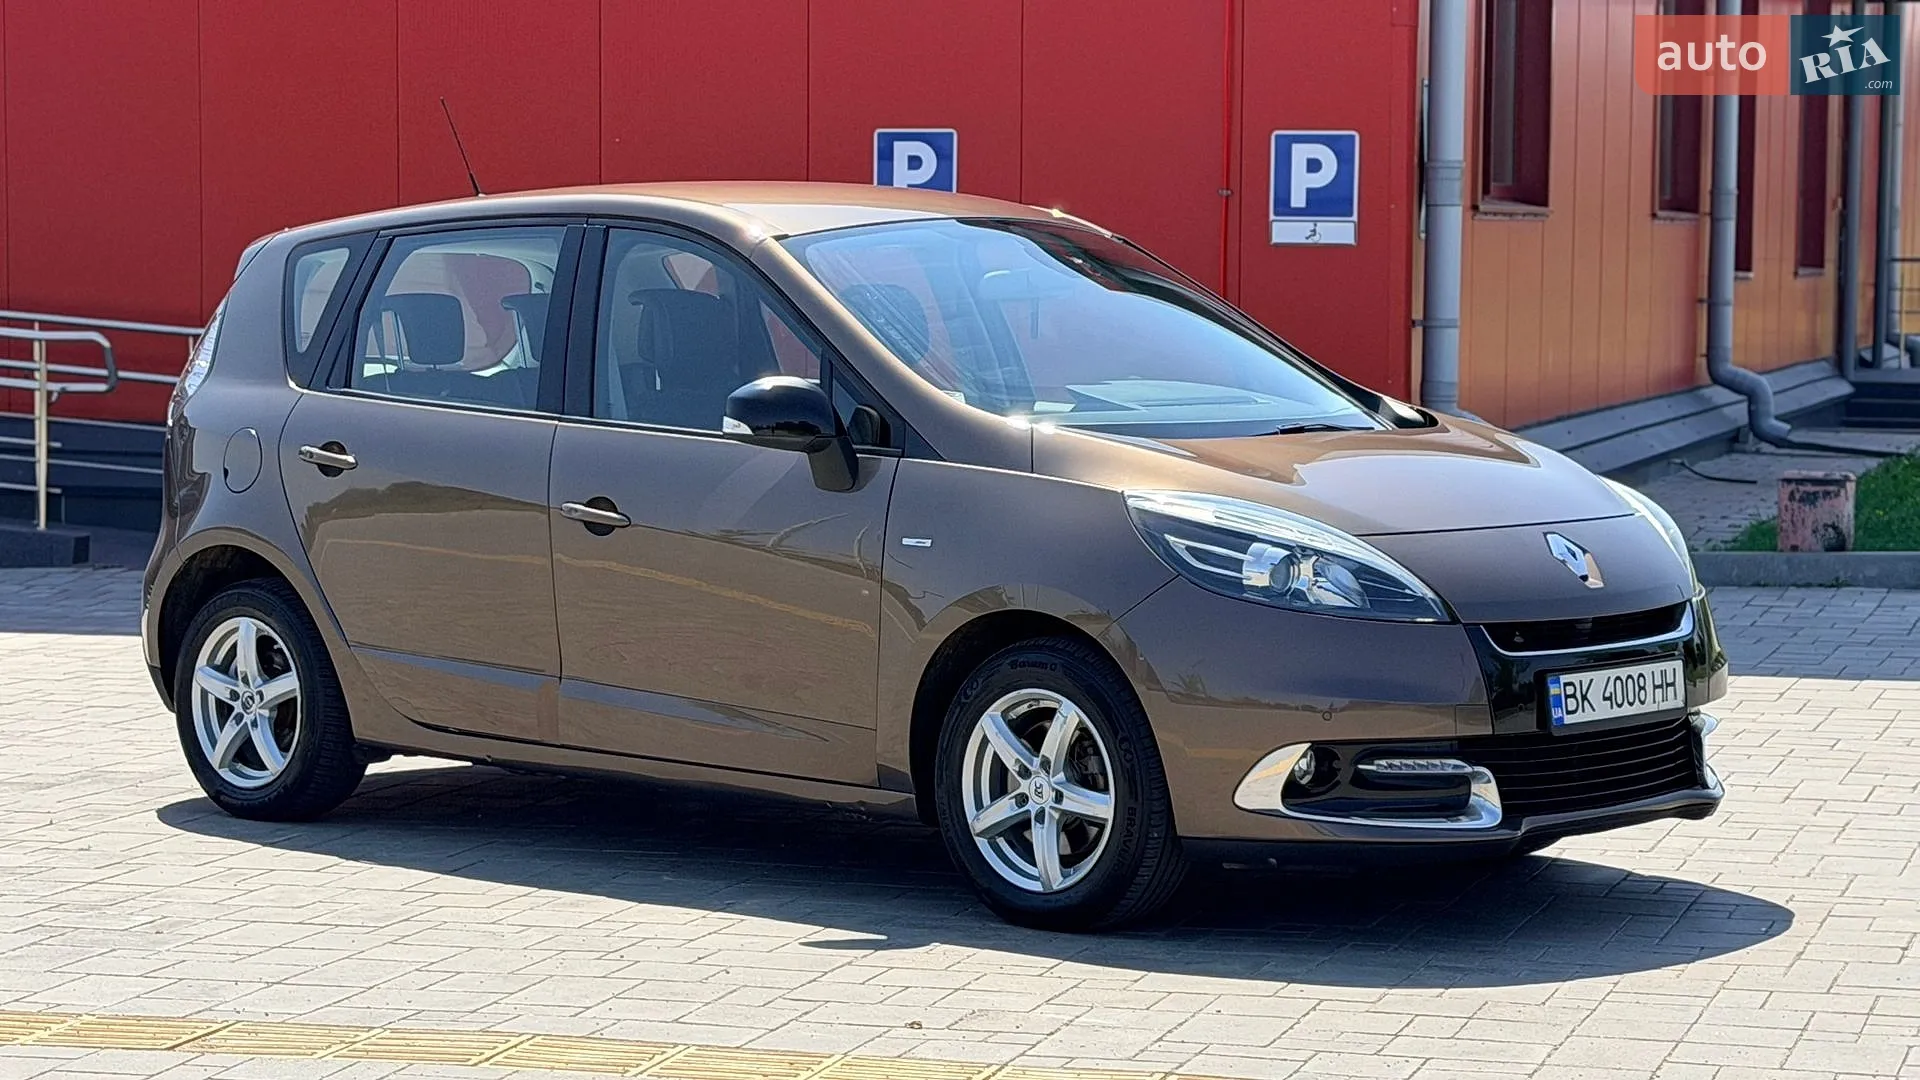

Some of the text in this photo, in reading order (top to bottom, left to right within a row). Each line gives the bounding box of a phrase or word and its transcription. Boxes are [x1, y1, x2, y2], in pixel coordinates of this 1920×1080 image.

[893, 141, 937, 187] P
[1290, 143, 1338, 208] P
[1554, 707, 1563, 718] UA
[1563, 668, 1677, 715] BK 4008 HH
